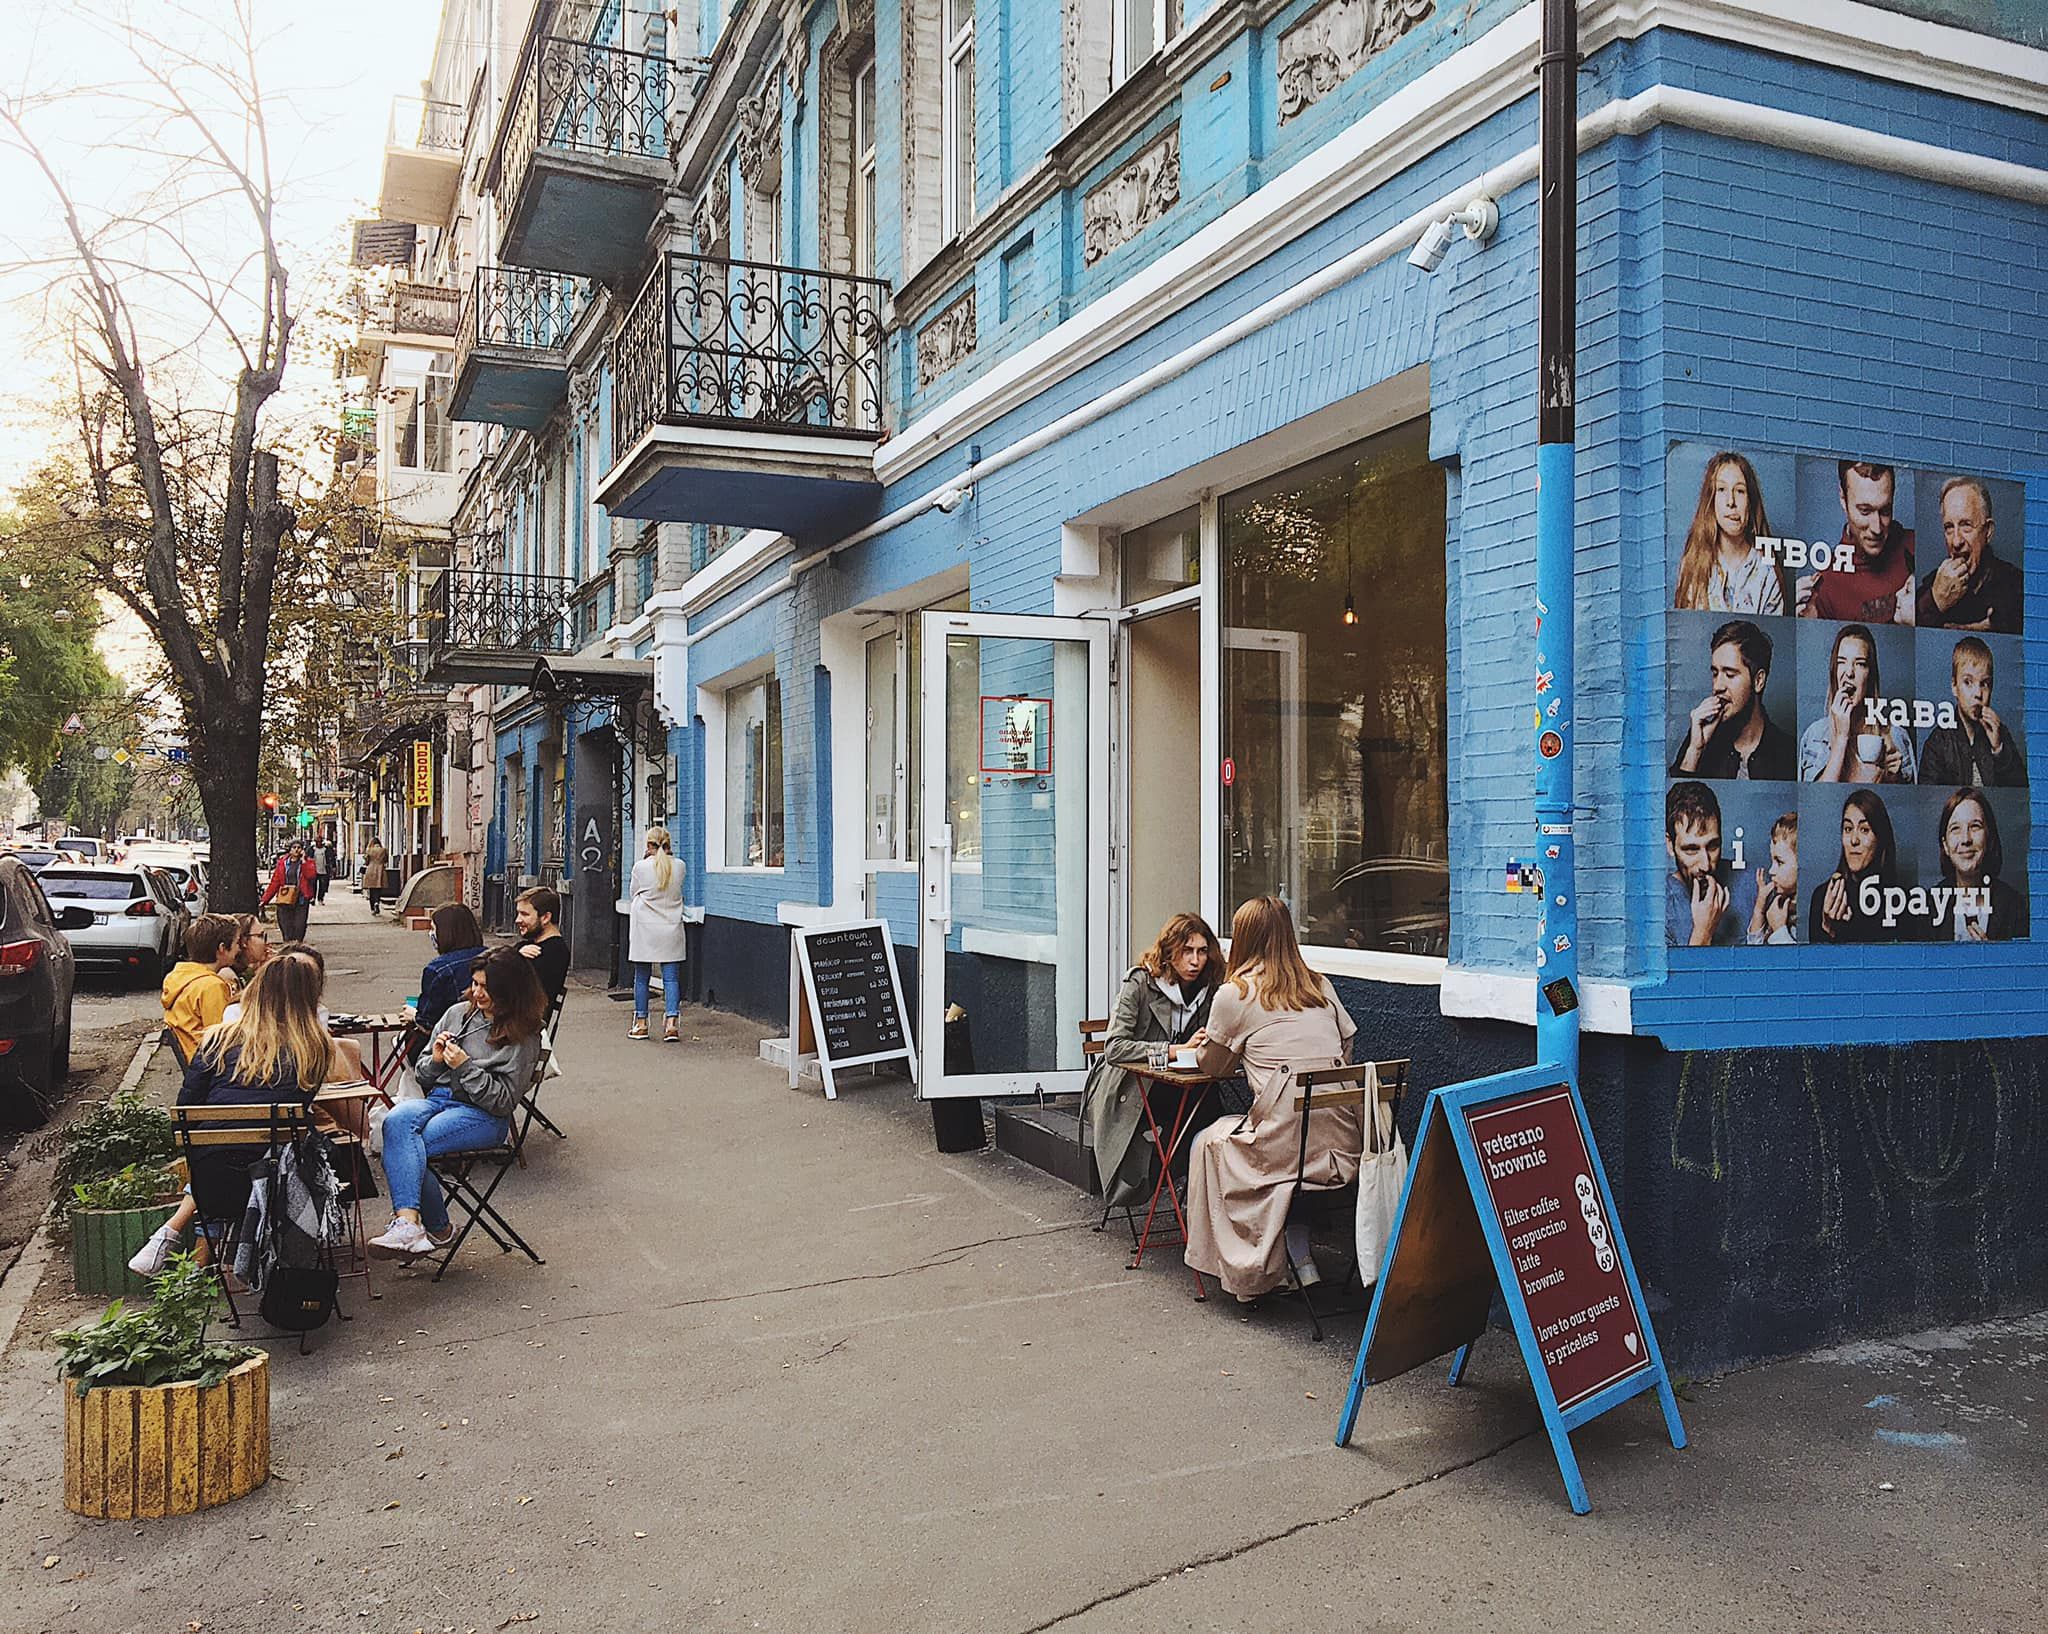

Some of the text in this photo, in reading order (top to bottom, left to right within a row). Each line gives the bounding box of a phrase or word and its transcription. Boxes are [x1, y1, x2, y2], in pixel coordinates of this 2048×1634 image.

[1864, 697, 1958, 729] кава
[416, 743, 429, 803] ПРОДУКТИ
[581, 846, 603, 872] 2
[1858, 874, 1994, 928] брауні
[816, 932, 868, 946] downtown
[1482, 1126, 1544, 1156] veterano
[1487, 1145, 1547, 1180] brownie
[1504, 1181, 1591, 1227] filter coffee 36
[1511, 1202, 1598, 1250] cappuccino 44
[1516, 1224, 1603, 1273] latte 49
[1523, 1253, 1612, 1296] brownie 69
[1537, 1295, 1620, 1342] love to our guests
[1544, 1330, 1599, 1366] is priceless
